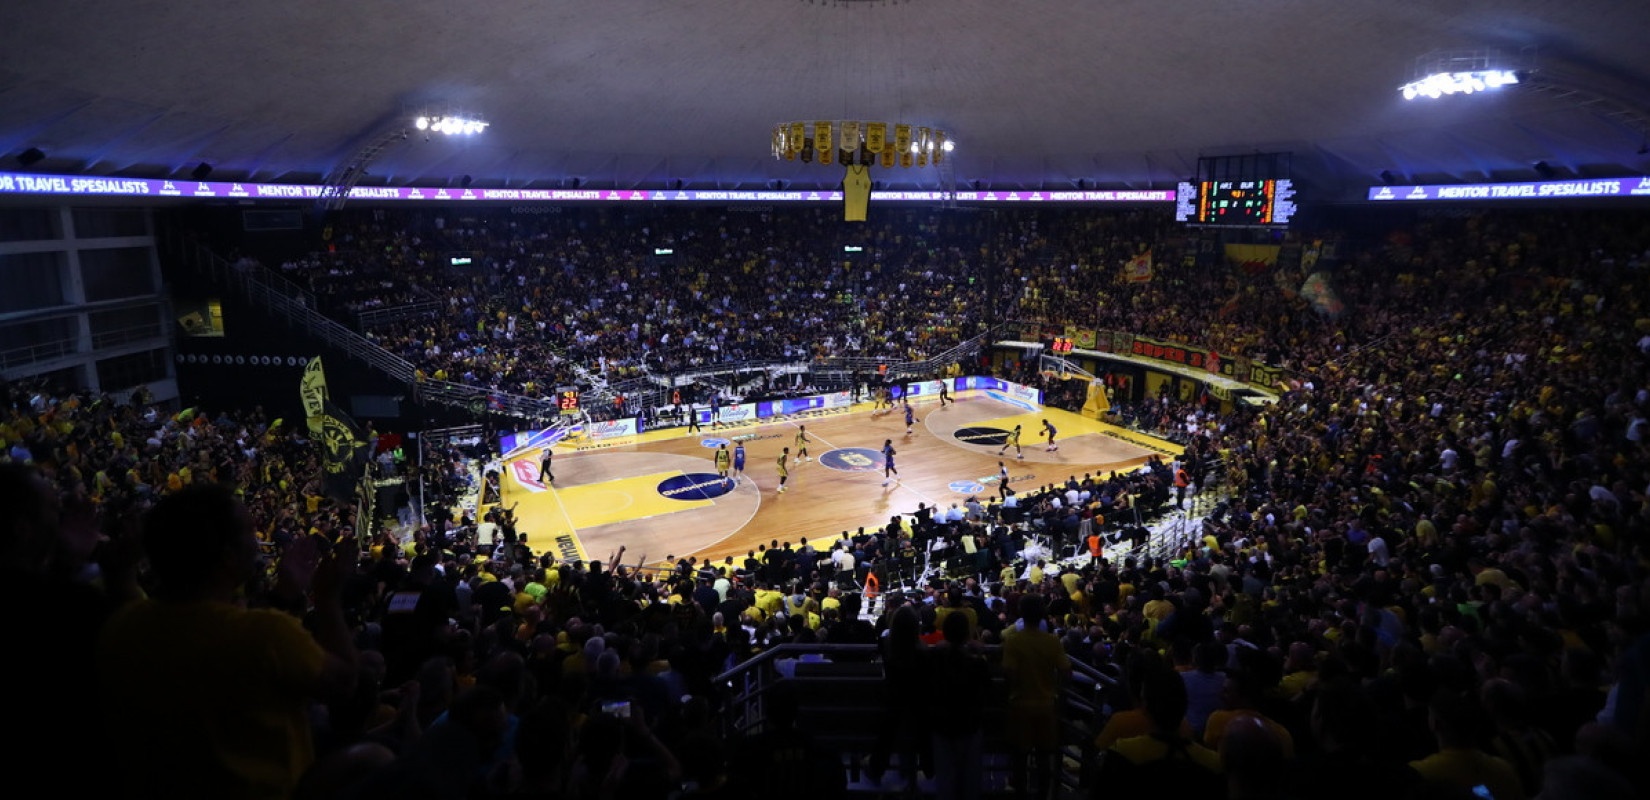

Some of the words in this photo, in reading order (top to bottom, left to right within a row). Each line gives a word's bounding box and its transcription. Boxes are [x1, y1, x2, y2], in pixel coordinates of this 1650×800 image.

[16, 177, 70, 192] TRAVEL
[71, 179, 149, 194] SPESIALISTS
[257, 185, 303, 197] MENTOR
[344, 187, 399, 198] PESIALISTS
[1438, 186, 1489, 198] MENTOR
[1490, 184, 1536, 197] TRAVEL
[1538, 182, 1620, 196] SPESIALISTS
[484, 190, 519, 199] MENTOR
[520, 190, 551, 199] TRAVEL
[1133, 341, 1185, 364] SUPER
[1189, 352, 1202, 367] 3
[561, 398, 577, 409] 22
